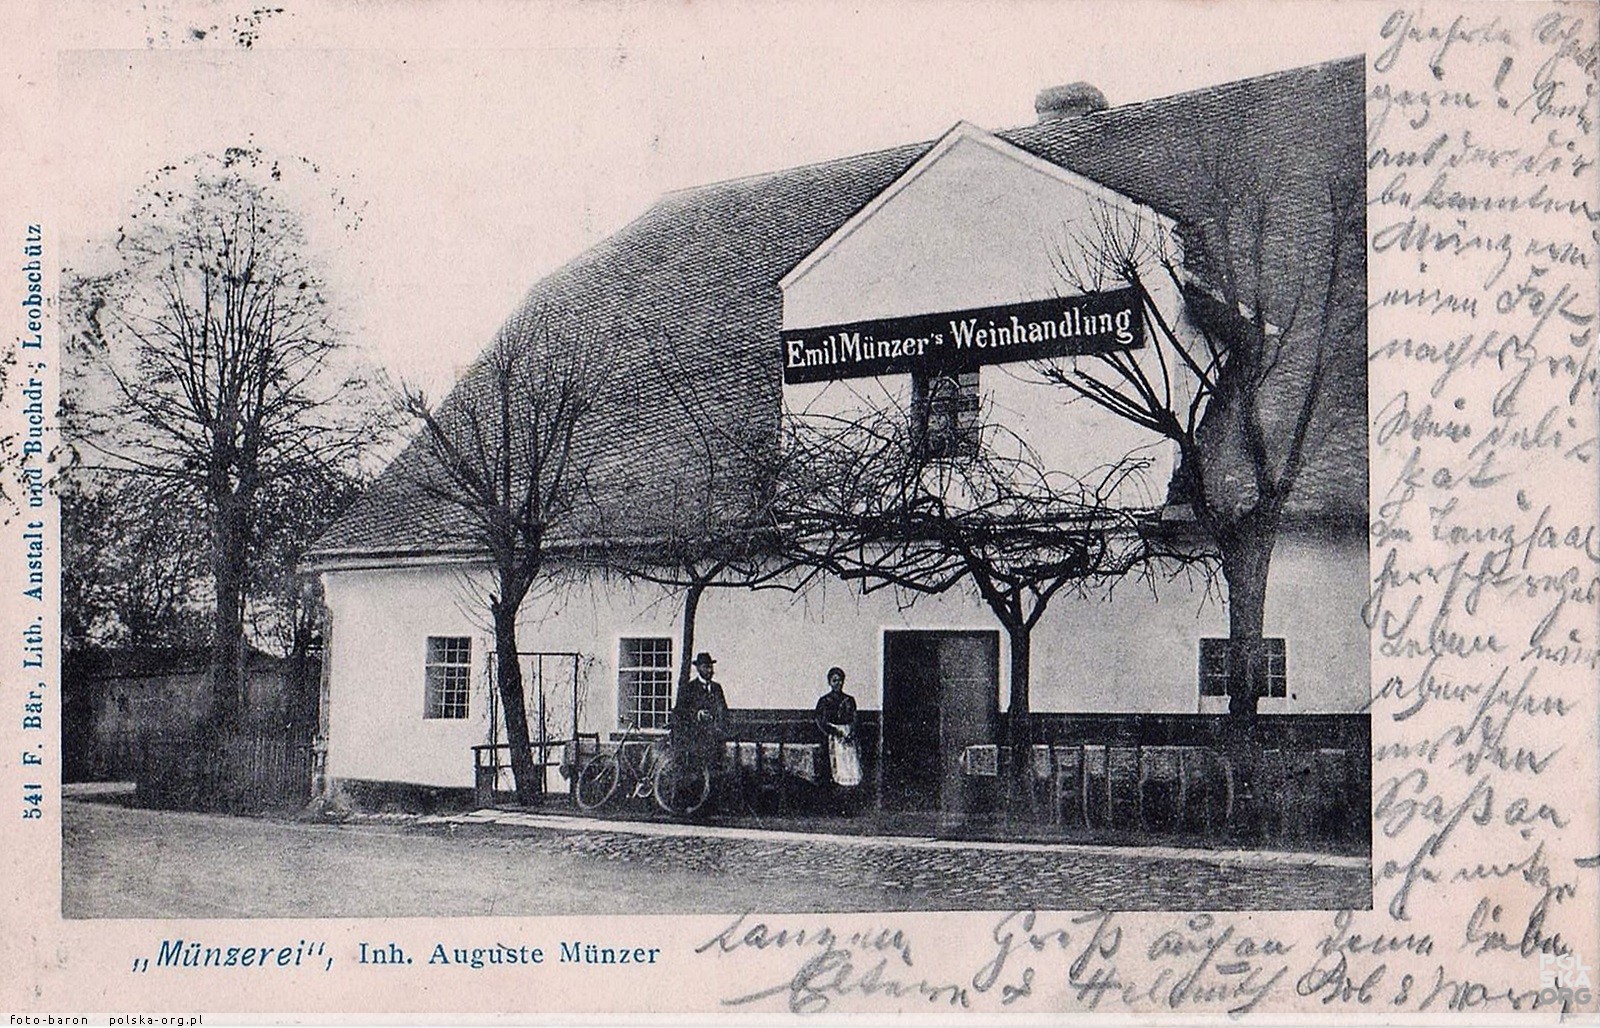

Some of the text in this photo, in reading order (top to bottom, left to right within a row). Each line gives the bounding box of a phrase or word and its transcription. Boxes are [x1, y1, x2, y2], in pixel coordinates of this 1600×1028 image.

[22, 222, 43, 350] Leobschütz
[786, 336, 838, 369] Emil
[949, 307, 1133, 350] Weinhandlung
[22, 467, 44, 508] und
[22, 520, 44, 601] Anstalt
[22, 614, 43, 669] Lith.
[22, 681, 47, 731] Bär,
[22, 744, 43, 766] F.
[23, 784, 43, 819] 541
[358, 942, 413, 965] Inh.
[428, 942, 544, 969] Auguste
[559, 941, 661, 965] Münzer
